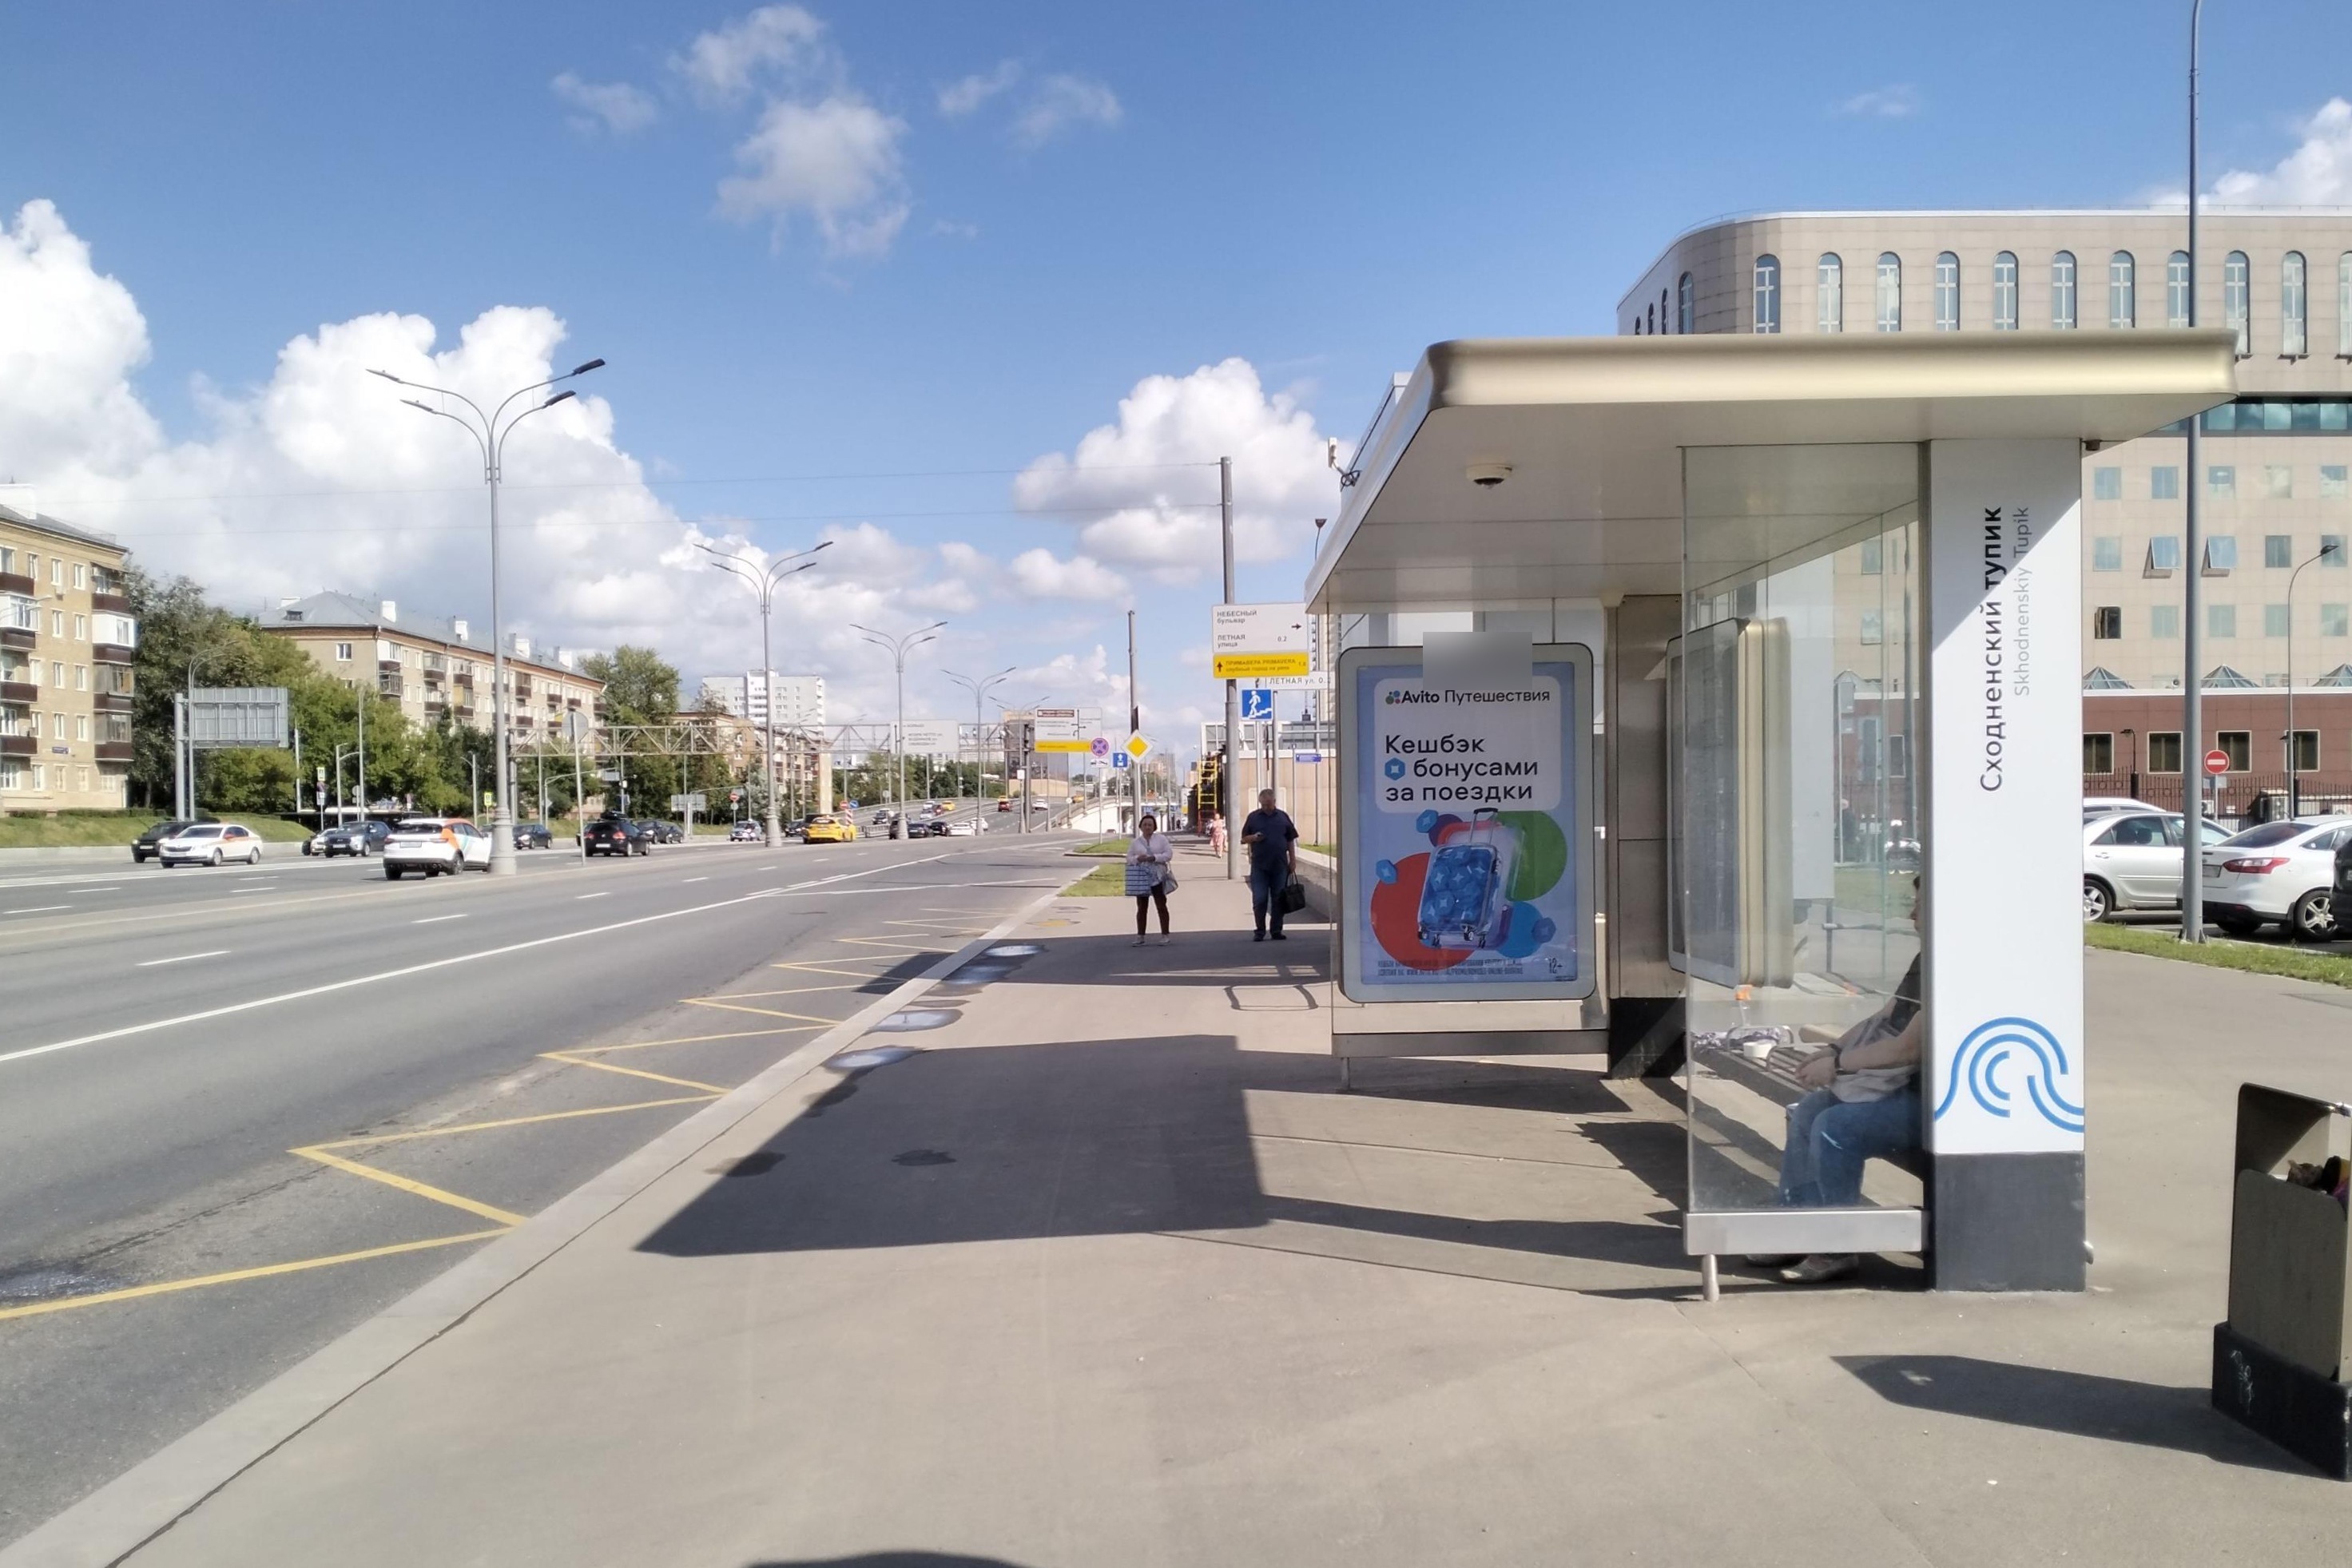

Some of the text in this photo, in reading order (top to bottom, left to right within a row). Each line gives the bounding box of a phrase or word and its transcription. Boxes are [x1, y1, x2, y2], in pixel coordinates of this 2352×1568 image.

[2012, 506, 2032, 697] Skhodnenskiy Tupik
[1980, 506, 2007, 792] Сходненский тупик
[1401, 689, 1550, 705] Avito Путешествия
[1386, 734, 1485, 753] Кешбэк
[1413, 758, 1538, 782] бонусами
[1385, 785, 1532, 804] за поездки
[1548, 957, 1563, 975] 12+
